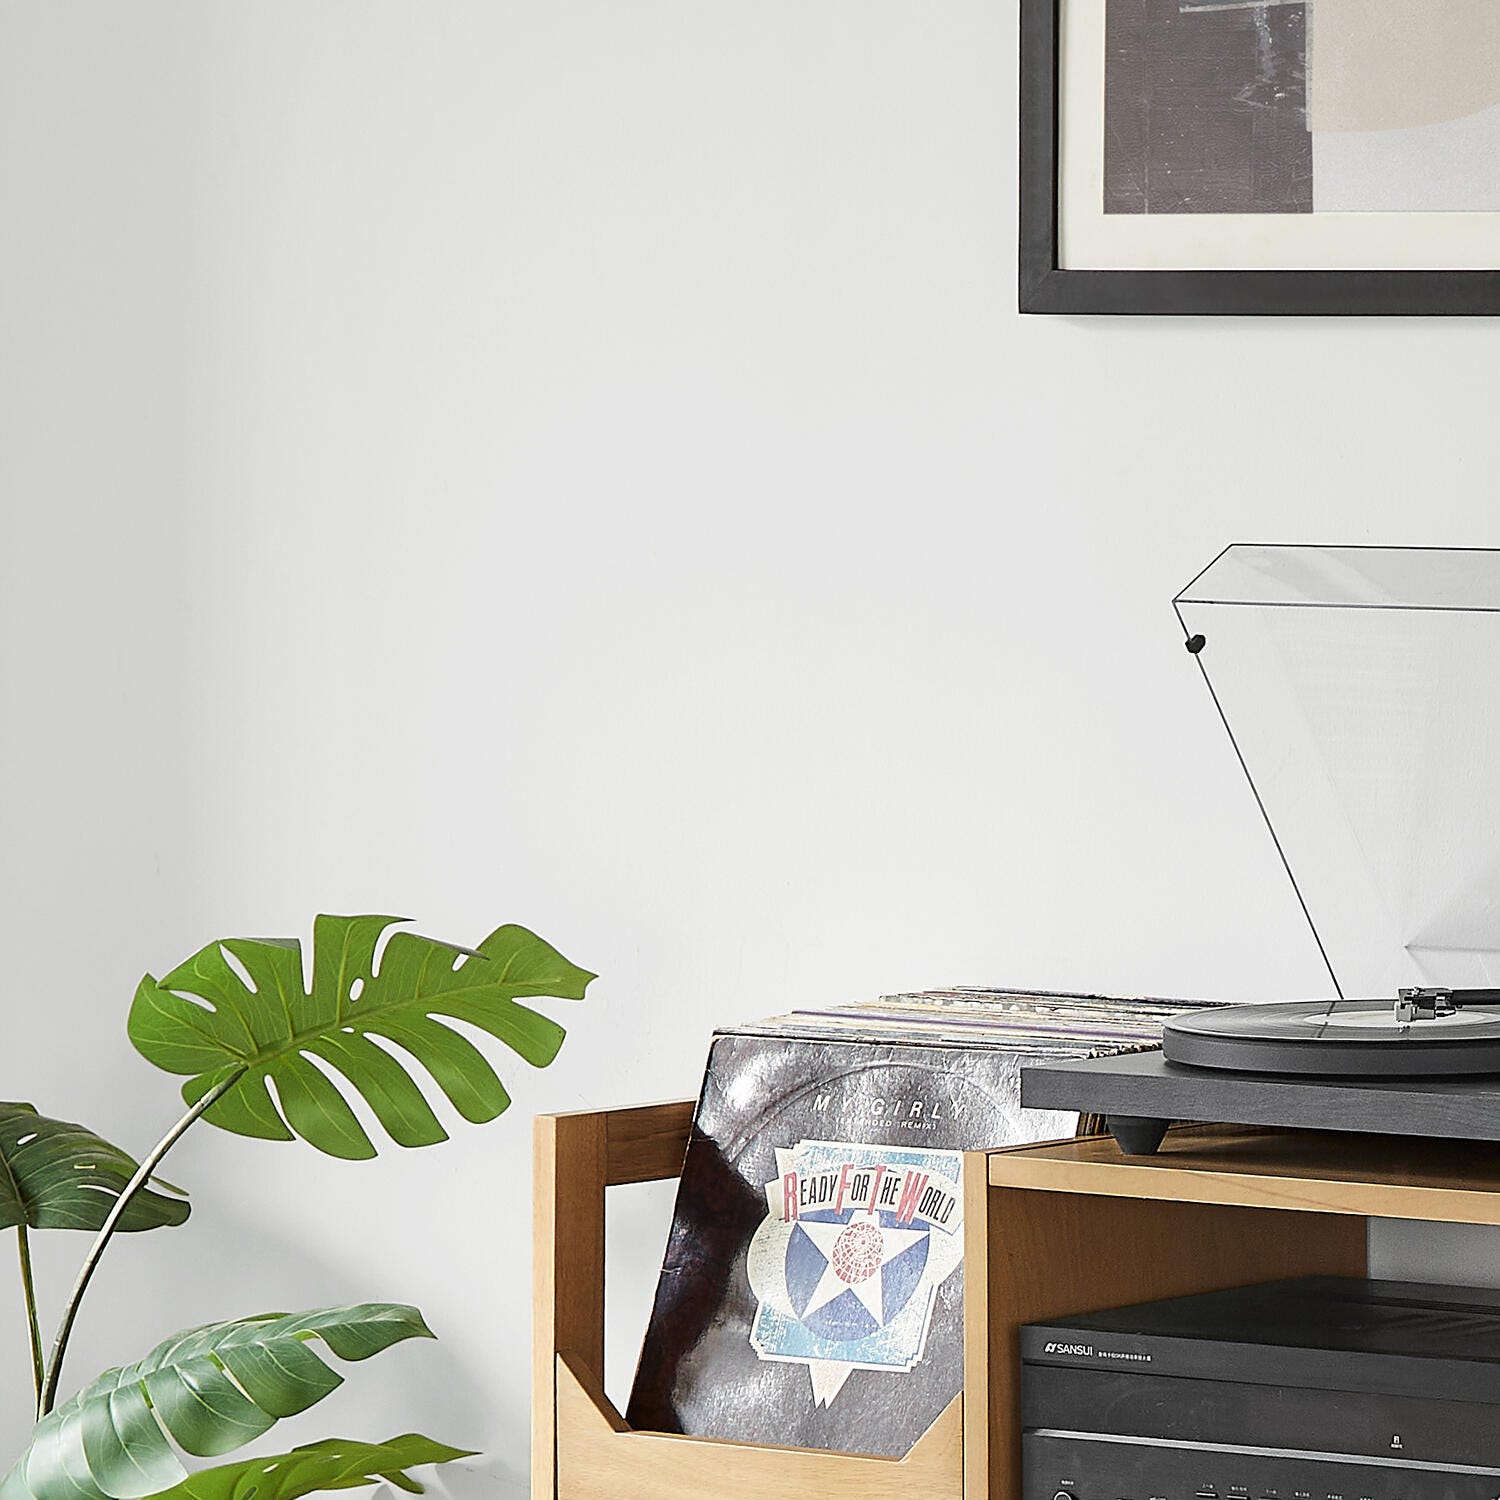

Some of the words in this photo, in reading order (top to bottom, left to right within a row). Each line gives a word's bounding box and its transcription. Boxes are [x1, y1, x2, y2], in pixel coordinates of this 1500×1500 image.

[812, 1094, 851, 1113] MY
[783, 1171, 839, 1223] READY
[834, 1164, 870, 1215] FOR
[867, 1165, 901, 1215] THE
[895, 1170, 956, 1225] WORLD
[1056, 1343, 1093, 1356] SANSUI
